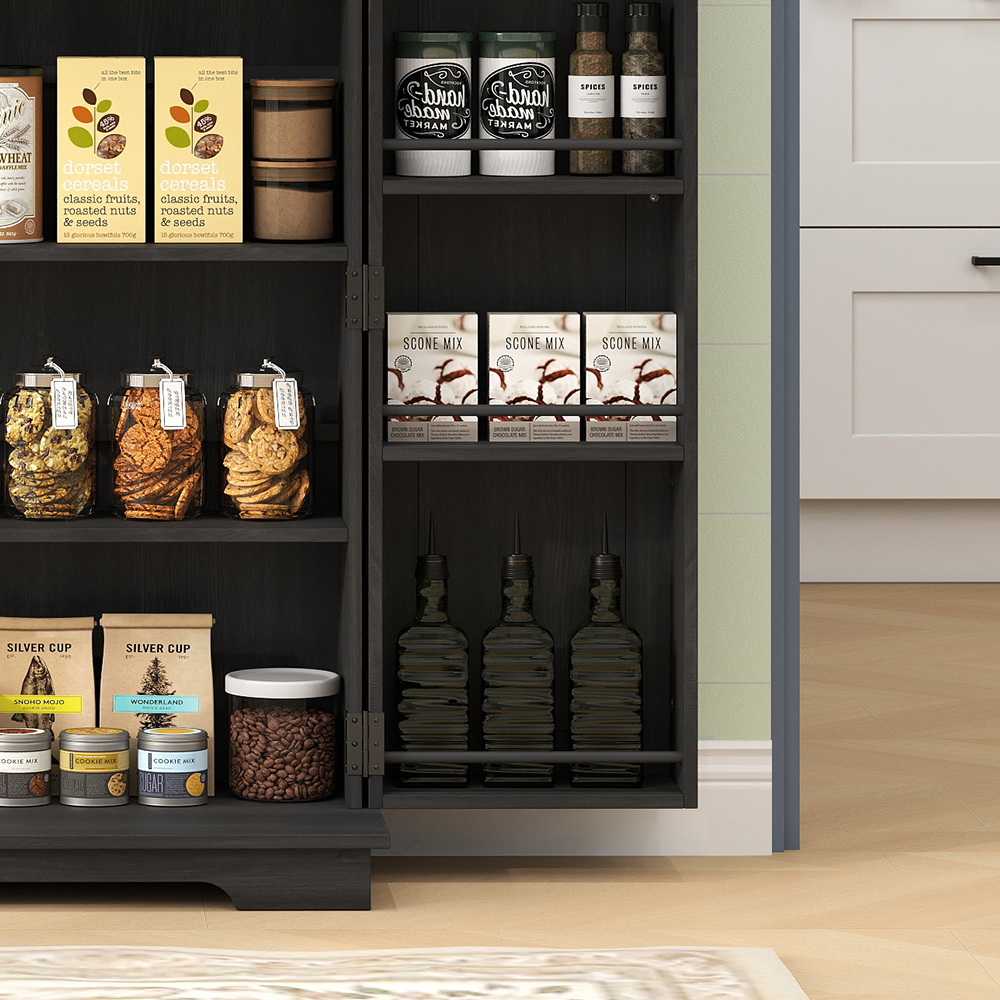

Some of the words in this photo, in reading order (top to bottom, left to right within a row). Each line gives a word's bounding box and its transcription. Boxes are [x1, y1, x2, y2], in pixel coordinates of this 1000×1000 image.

[63, 160, 121, 174] dorset
[160, 160, 218, 174] dorset
[63, 177, 128, 191] cereals
[160, 177, 225, 191] cereals
[63, 194, 102, 204] classic
[105, 194, 140, 205] fruits,
[160, 194, 199, 204] classic
[202, 194, 237, 205] fruits,
[63, 206, 107, 215] roasted
[110, 206, 137, 215] nuts
[160, 206, 204, 215] roasted
[207, 206, 234, 215] nuts
[63, 217, 73, 227] &
[76, 217, 108, 227] seeds
[160, 217, 170, 227] &
[173, 217, 205, 227] seeds
[403, 337, 438, 350] SCONE
[443, 337, 463, 350] MIX
[505, 337, 541, 350] SCONE
[545, 337, 565, 350] MIX
[602, 337, 637, 350] SCONE
[642, 337, 662, 350] MIX
[7, 643, 45, 652] SILVER
[49, 643, 72, 652] CUP
[126, 643, 164, 653] SILVER
[168, 644, 191, 653] CUP
